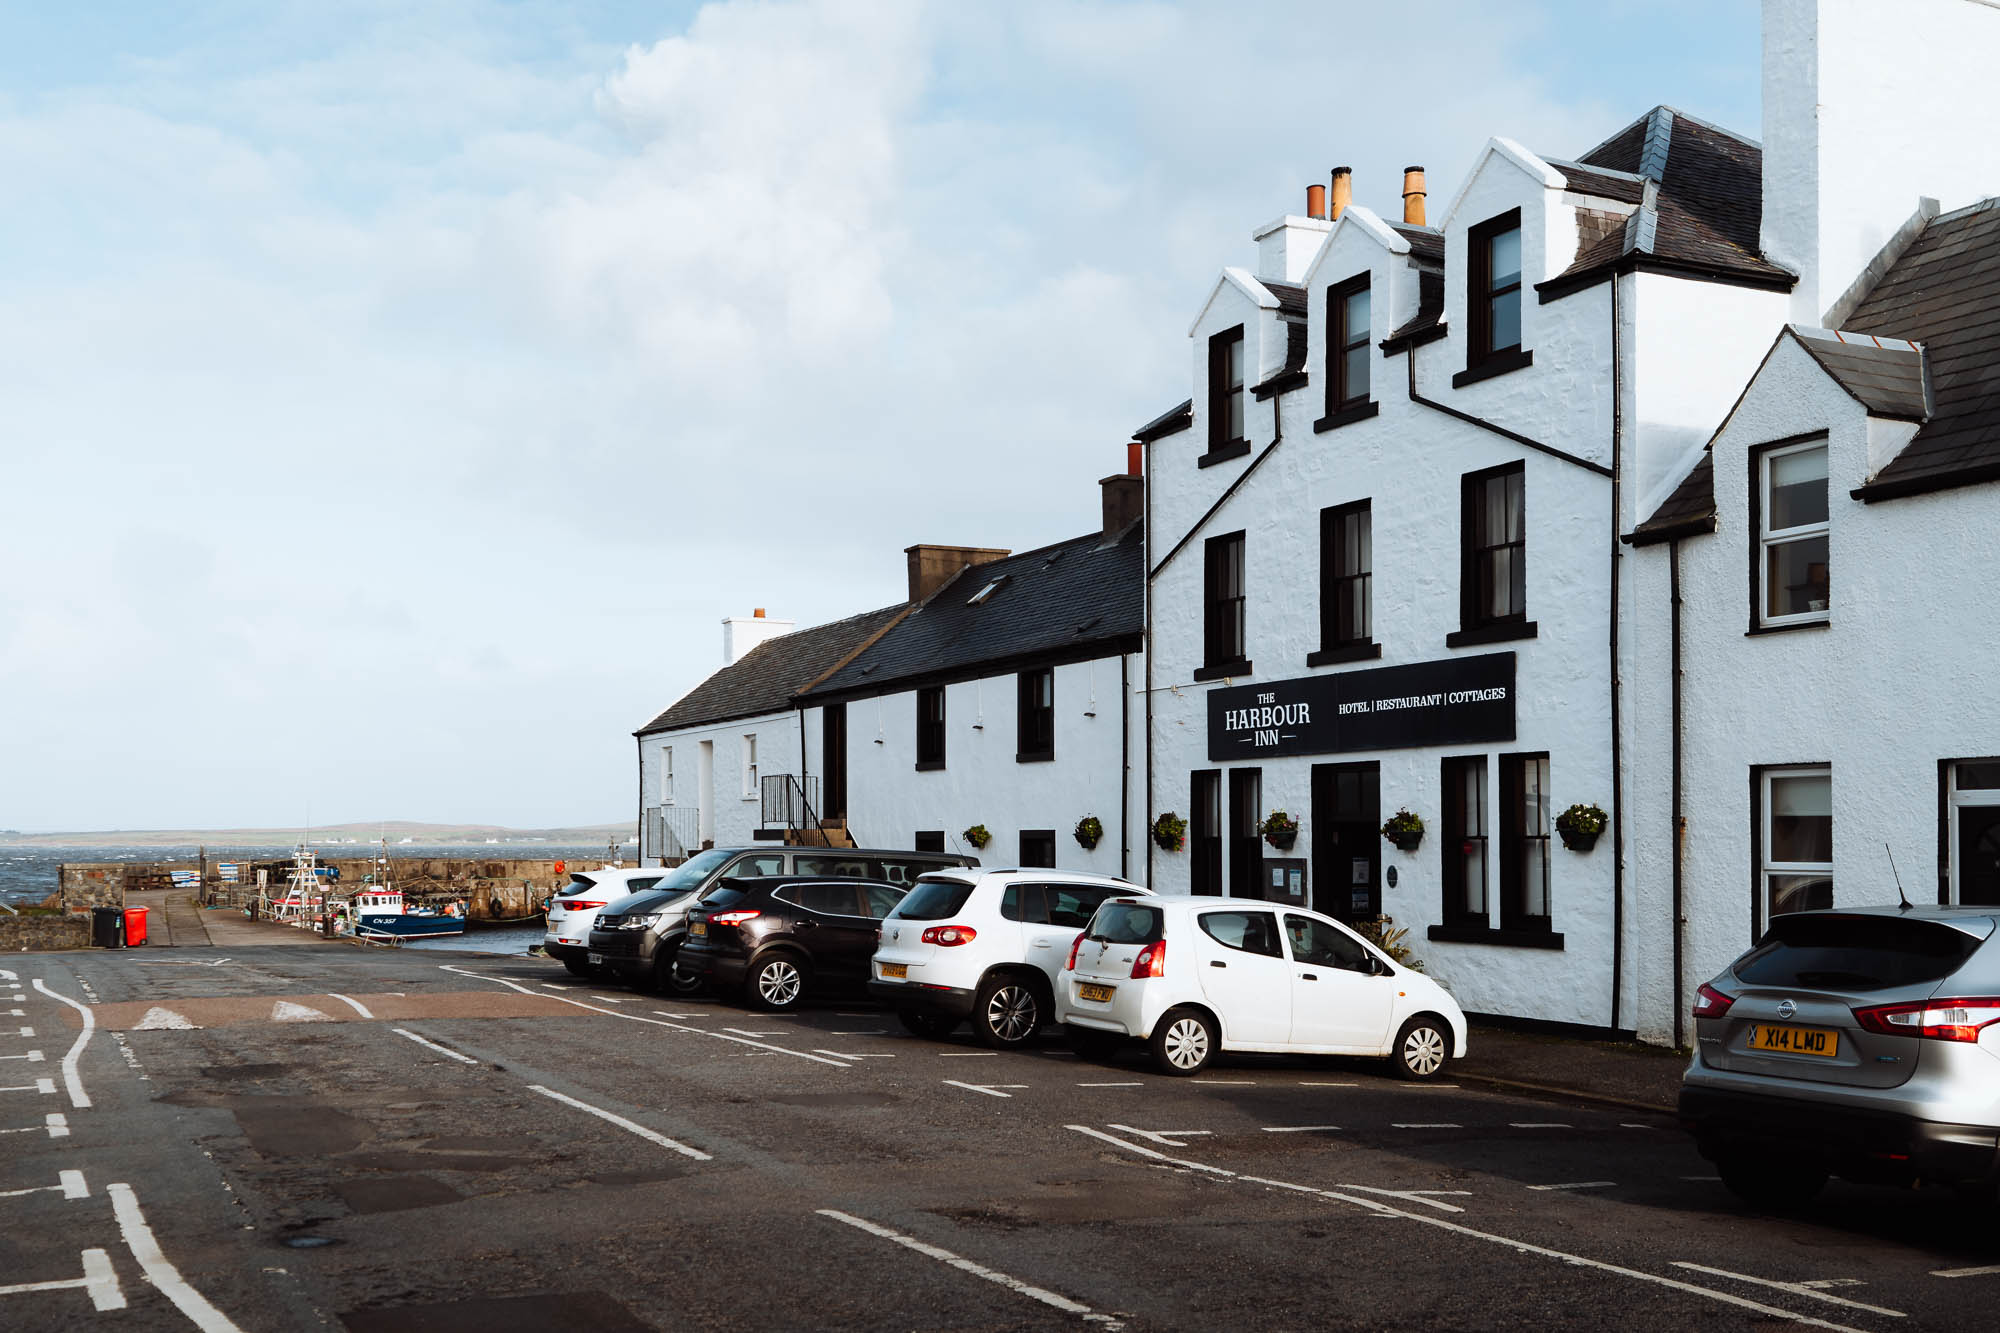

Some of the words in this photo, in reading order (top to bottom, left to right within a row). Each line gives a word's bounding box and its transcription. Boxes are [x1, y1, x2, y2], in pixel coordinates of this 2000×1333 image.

[1257, 692, 1276, 705] THE
[1338, 701, 1370, 715] HOTEL
[1376, 693, 1442, 711] RESTAURANT
[1448, 687, 1506, 704] COTTAGES
[1225, 703, 1311, 731] HARBOUR
[1255, 729, 1279, 747] INN
[1765, 1028, 1790, 1049] X14
[1793, 1031, 1826, 1052] LMD
